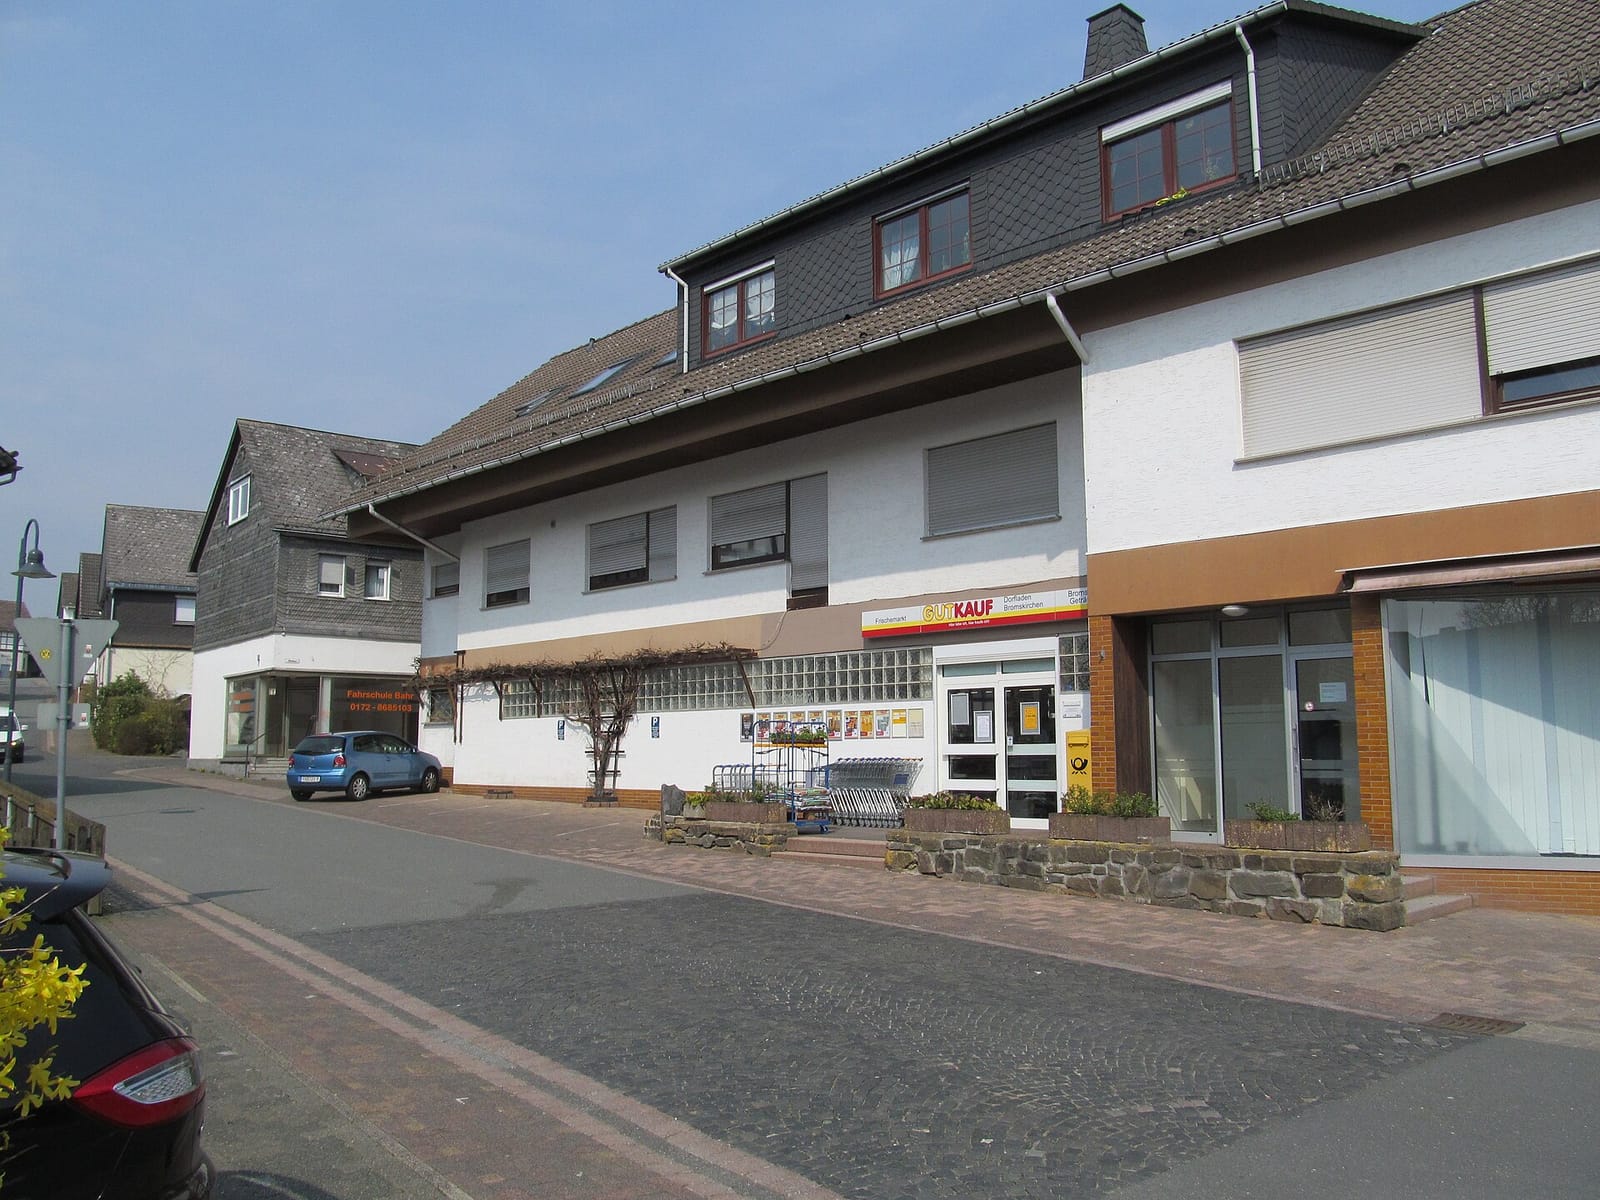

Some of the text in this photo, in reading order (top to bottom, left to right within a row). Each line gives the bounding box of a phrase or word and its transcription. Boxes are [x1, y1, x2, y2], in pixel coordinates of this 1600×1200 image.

[1003, 594, 1032, 603] Dorfladen
[1003, 601, 1044, 611] Bromskirchen
[922, 600, 993, 622] GUTKAUF
[347, 690, 393, 699] Fahrschule
[350, 703, 371, 711] 0172
